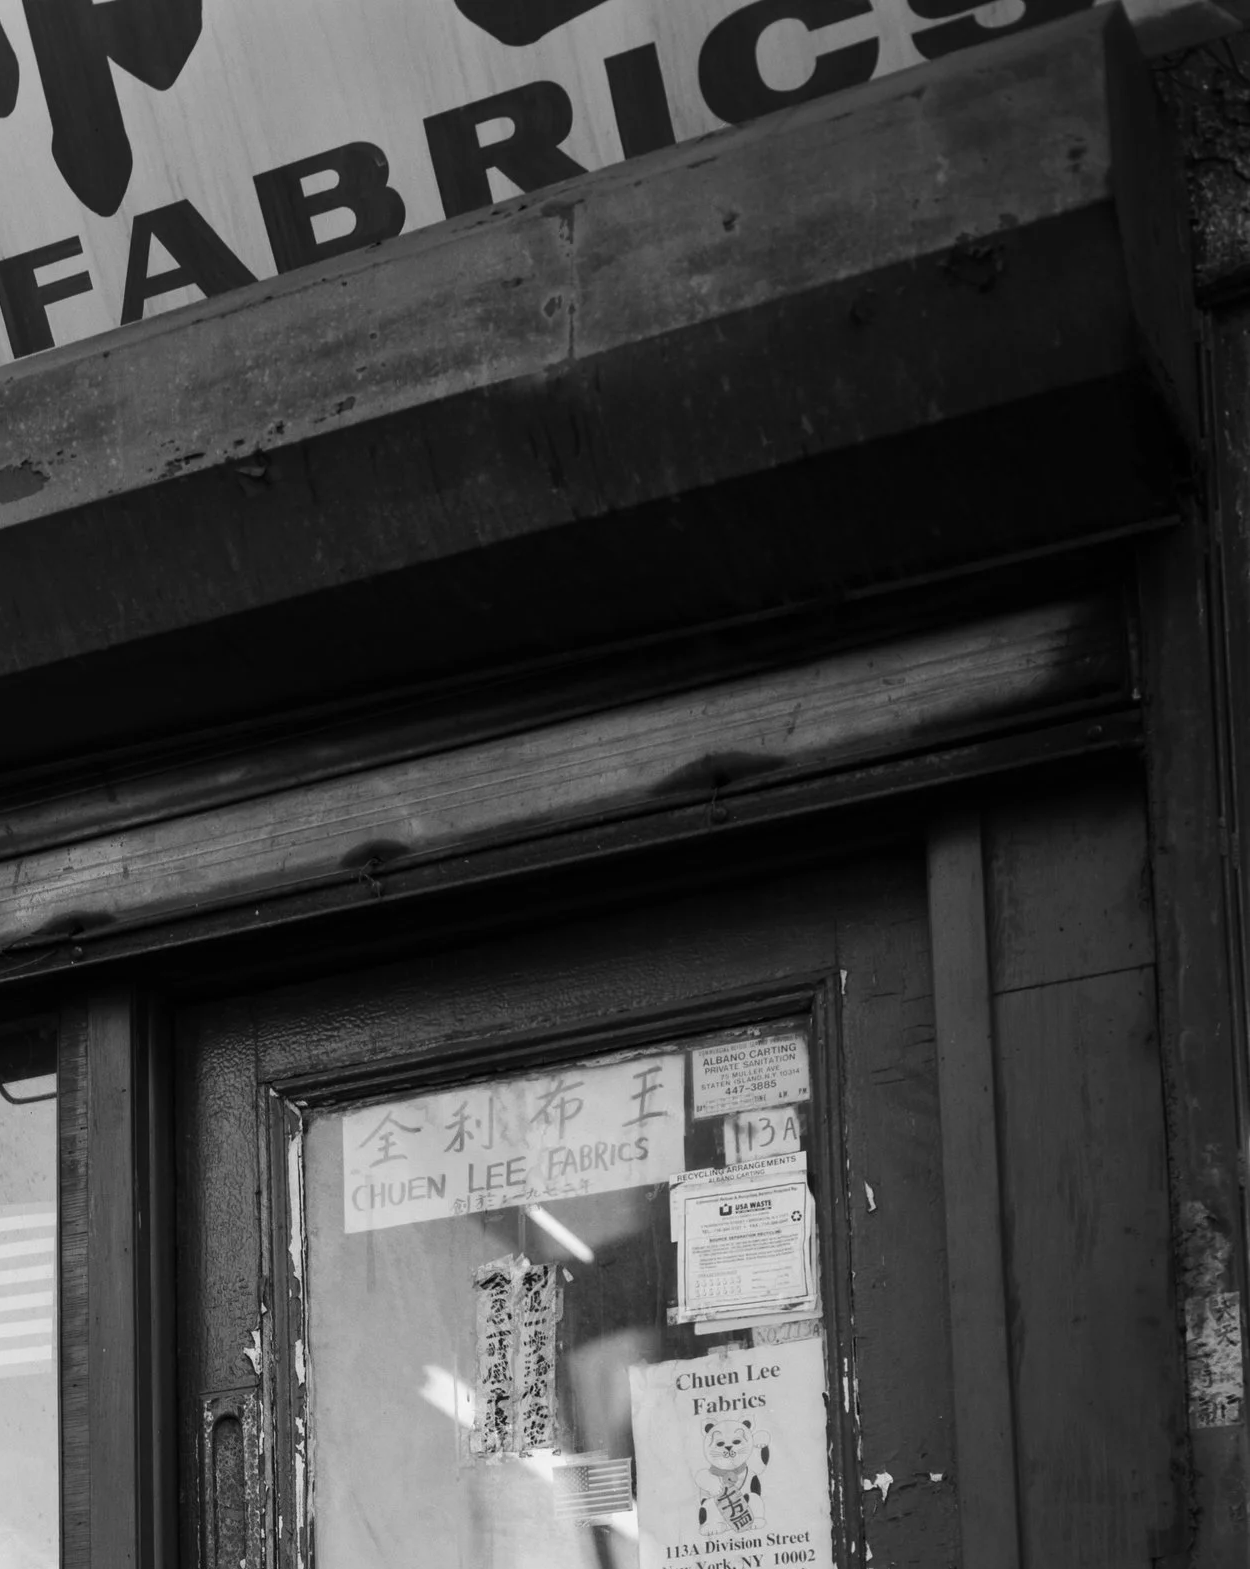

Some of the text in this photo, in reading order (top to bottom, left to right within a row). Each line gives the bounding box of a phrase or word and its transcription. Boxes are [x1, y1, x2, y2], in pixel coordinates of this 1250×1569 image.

[703, 1051, 746, 1067] ALBANO
[749, 1043, 797, 1059] CARTING
[705, 1054, 796, 1075] PRIVATE SANITATION
[701, 1080, 732, 1091] STATEN
[725, 1080, 777, 1095] 447-3885
[359, 1066, 667, 1168] 全利布王
[352, 1137, 650, 1212] CHUEN LEE FABRICS
[676, 1155, 797, 1182] RECYCLING ARRANGEMENTS
[708, 1169, 765, 1183] ALBANO CARTING
[735, 1203, 748, 1211] USA
[750, 1200, 772, 1208] WASTE
[676, 1363, 781, 1391] Chuen Lee
[692, 1392, 767, 1416] Fabrics
[666, 1531, 810, 1559] 113A Division Street
[741, 1554, 764, 1569] NY
[773, 1549, 816, 1565] 10002
